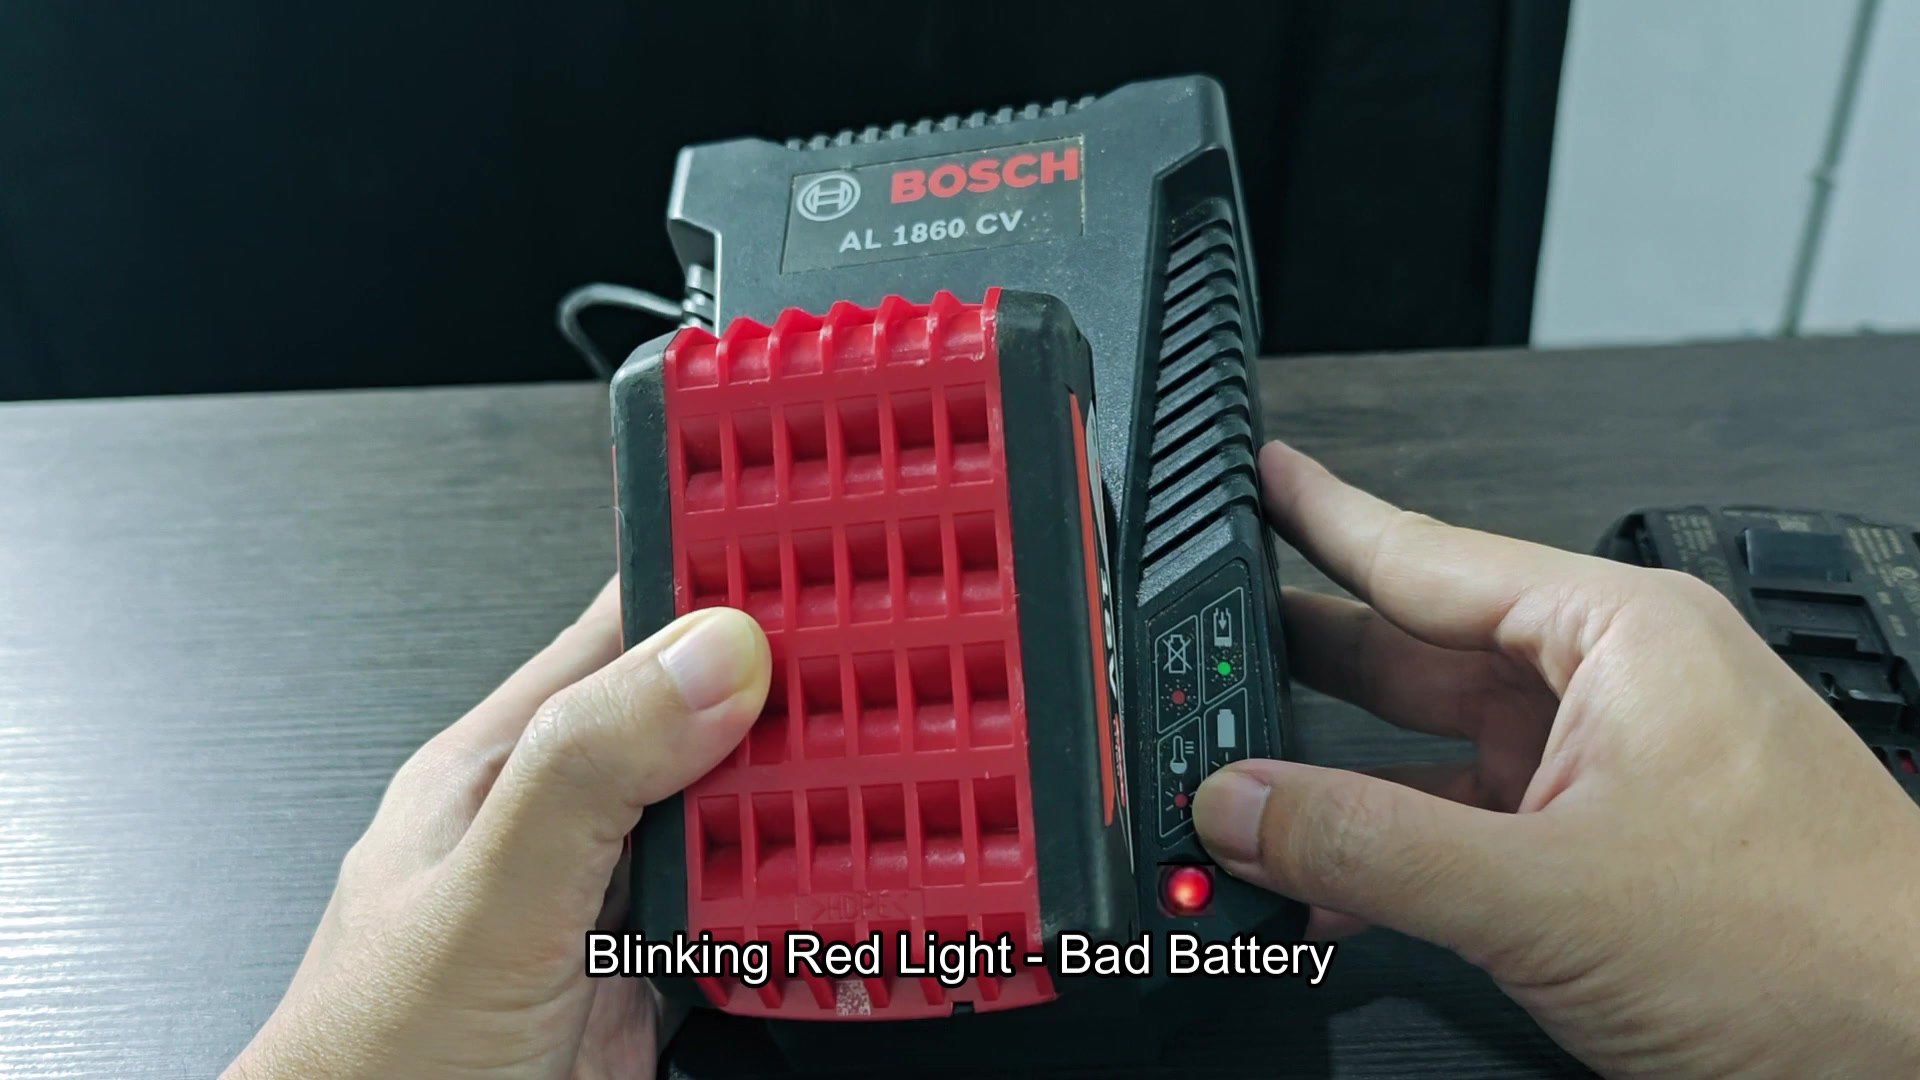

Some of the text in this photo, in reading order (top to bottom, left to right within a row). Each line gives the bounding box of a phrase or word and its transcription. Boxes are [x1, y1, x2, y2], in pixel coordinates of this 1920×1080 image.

[891, 147, 1080, 204] BOSCH
[839, 209, 1023, 253] AL 1860 CV
